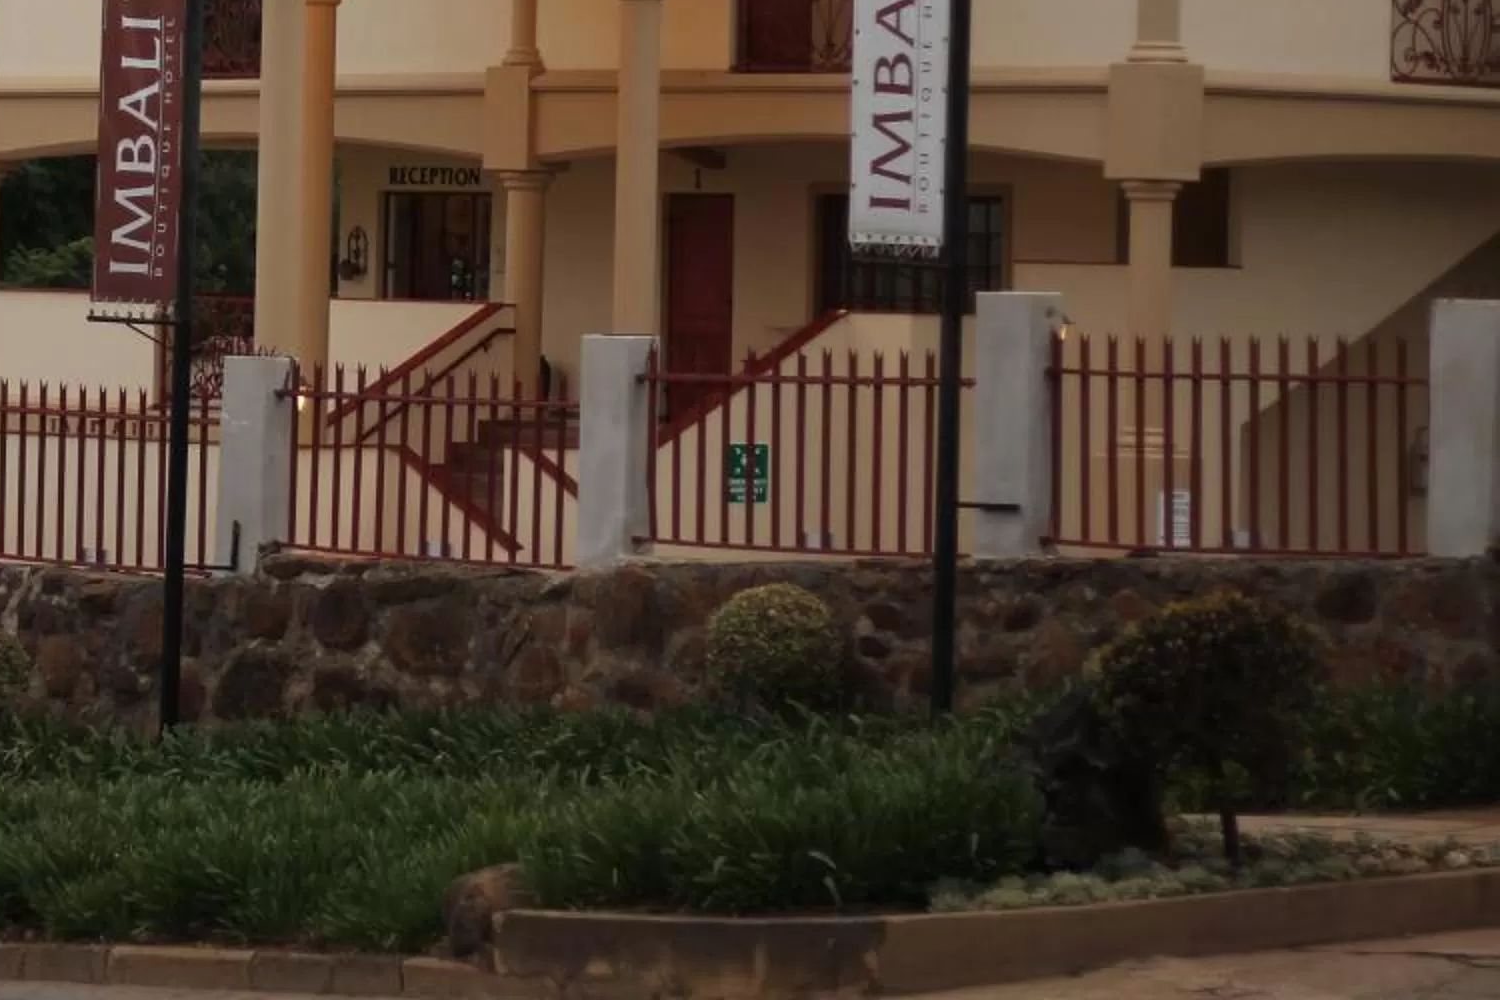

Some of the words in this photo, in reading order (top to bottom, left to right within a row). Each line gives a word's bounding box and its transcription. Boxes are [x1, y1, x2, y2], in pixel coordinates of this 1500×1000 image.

[109, 15, 161, 275] IMBALI
[154, 123, 171, 278] BOUTIQUE
[389, 167, 481, 186] RECEPTION
